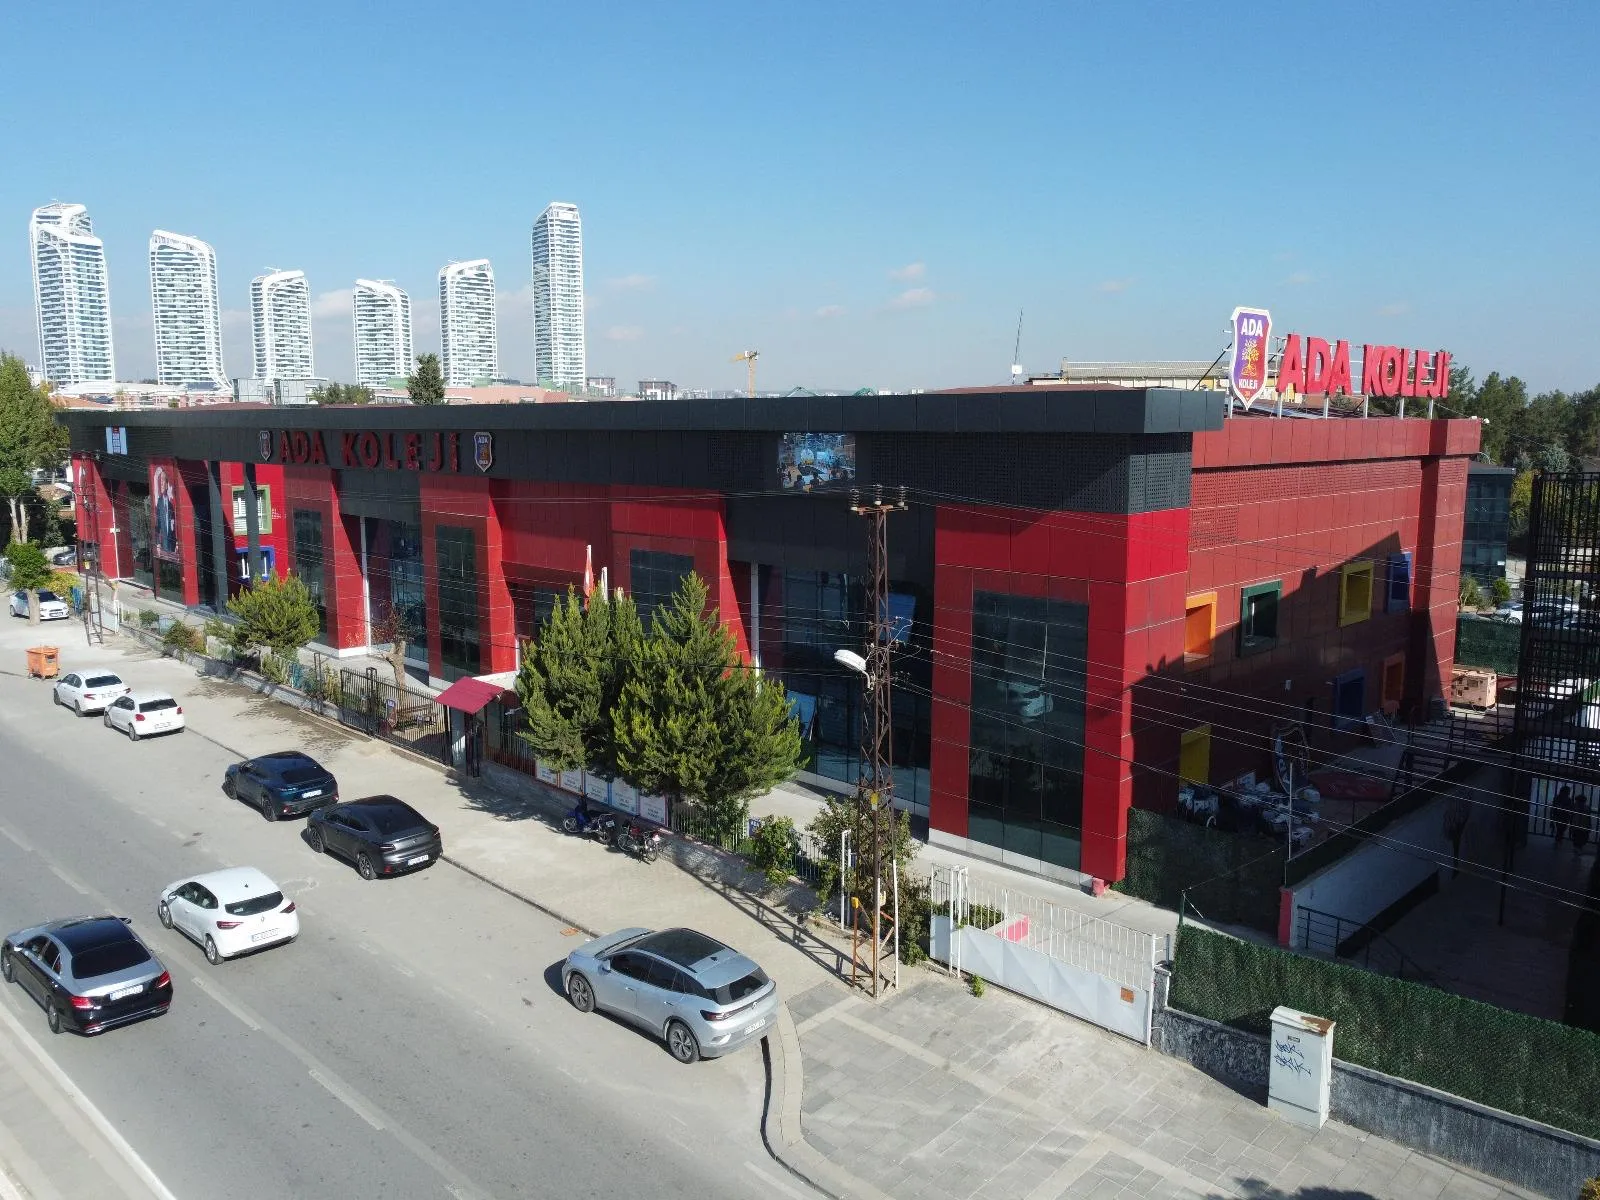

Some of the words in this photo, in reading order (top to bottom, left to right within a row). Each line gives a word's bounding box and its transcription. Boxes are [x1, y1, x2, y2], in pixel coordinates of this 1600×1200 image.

[1240, 317, 1263, 337] ADA
[1276, 333, 1352, 396] ADA
[279, 430, 326, 464] ADA
